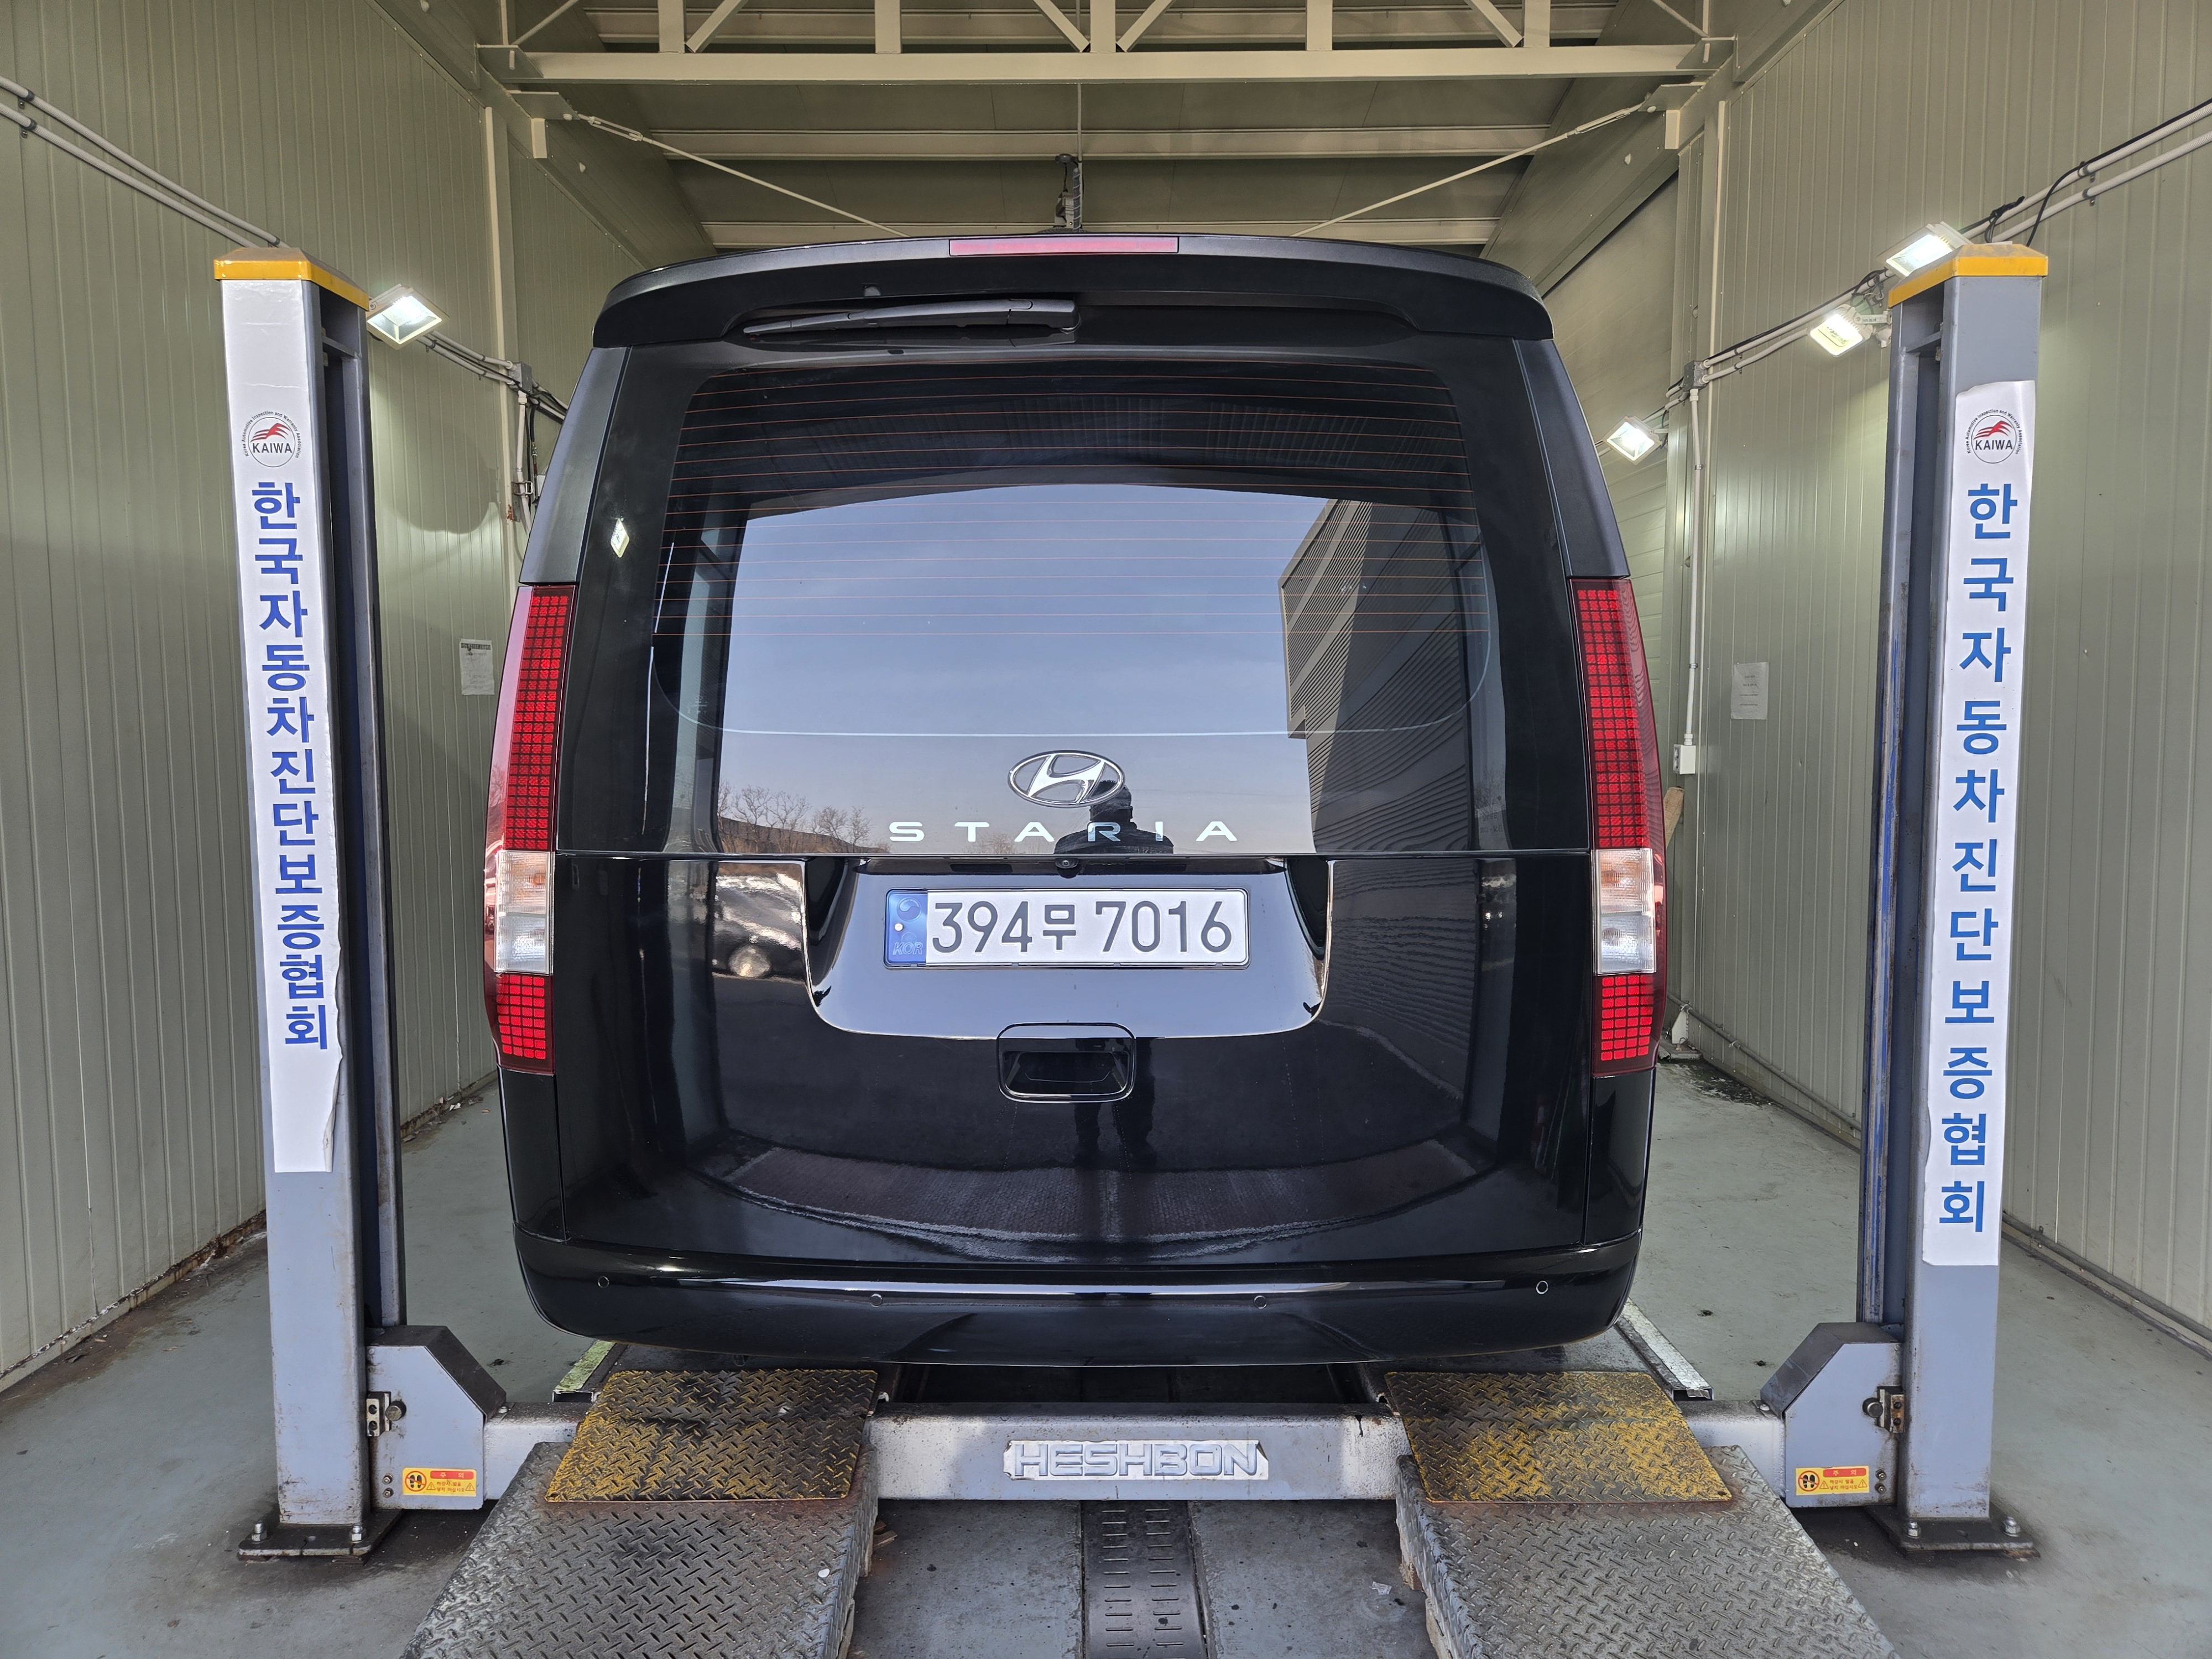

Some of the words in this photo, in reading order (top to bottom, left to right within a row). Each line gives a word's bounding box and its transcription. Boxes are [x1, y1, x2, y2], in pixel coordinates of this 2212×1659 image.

[242, 419, 253, 442] Automotive
[252, 411, 274, 420] Inspection
[283, 415, 298, 431] Warranty
[1965, 418, 1978, 440] Automotive
[2007, 413, 2021, 429] Warranty
[253, 443, 293, 453] KAIWA
[1975, 440, 2013, 450] KAIWA
[252, 482, 327, 1050] 한국자동차진단보증협회
[889, 821, 1237, 842] STARIA
[1939, 483, 2017, 1232] 한국자동차진단보증협회
[932, 900, 1077, 953] 394무
[1095, 900, 1232, 953] 7016
[892, 942, 923, 955] KOR
[1014, 1443, 1258, 1477] HESHBON
